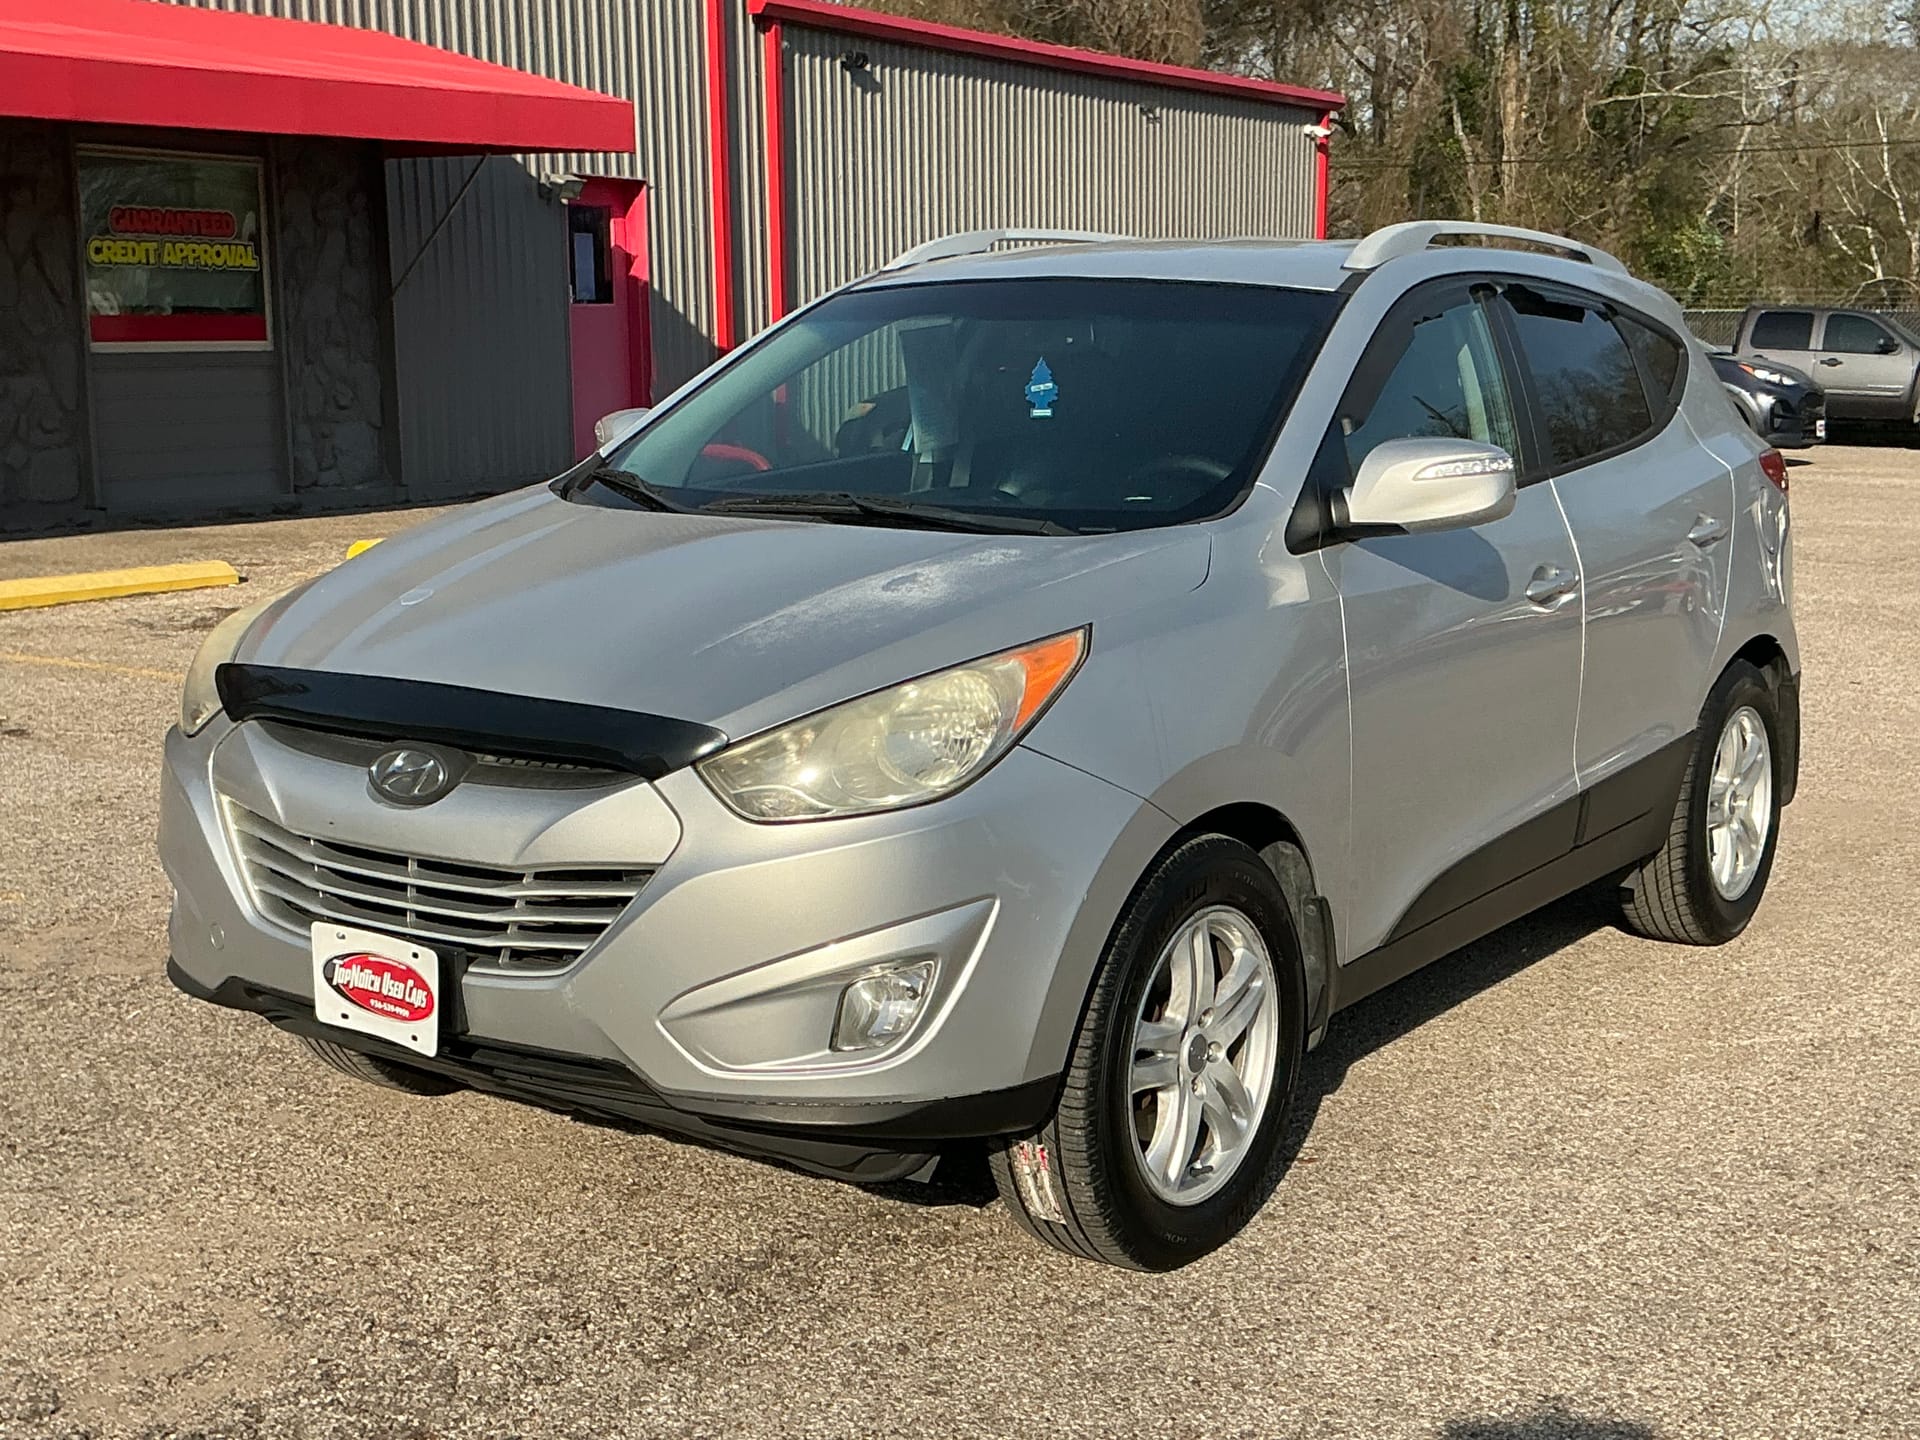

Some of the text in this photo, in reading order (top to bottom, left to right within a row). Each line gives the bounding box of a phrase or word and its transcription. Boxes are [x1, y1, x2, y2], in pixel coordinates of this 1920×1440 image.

[110, 207, 234, 236] GUARANTEED
[89, 239, 258, 269] CREDIT APPROVAL
[381, 972, 405, 1000] USED
[405, 979, 428, 1009] CARS
